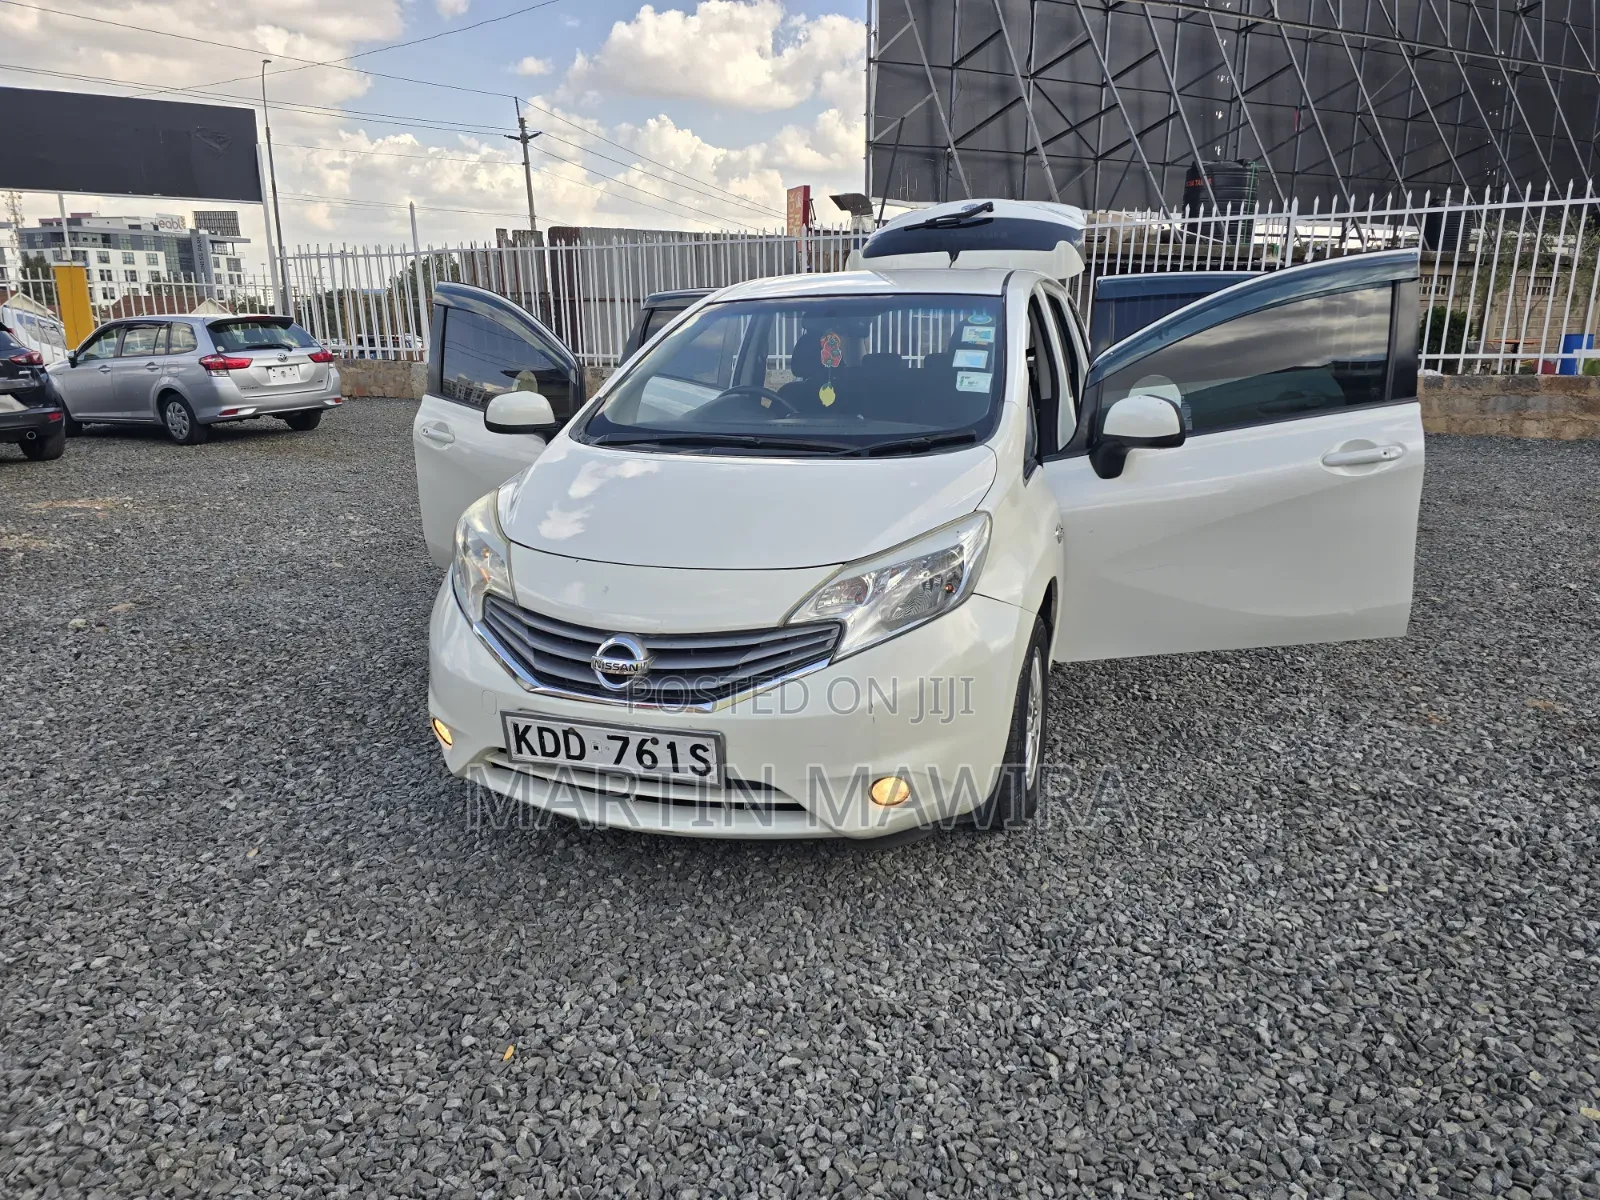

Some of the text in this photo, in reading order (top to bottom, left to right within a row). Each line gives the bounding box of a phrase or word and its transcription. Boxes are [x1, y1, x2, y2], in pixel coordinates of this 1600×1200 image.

[594, 659, 638, 672] NISSAN
[512, 722, 712, 777] KDD 761S
